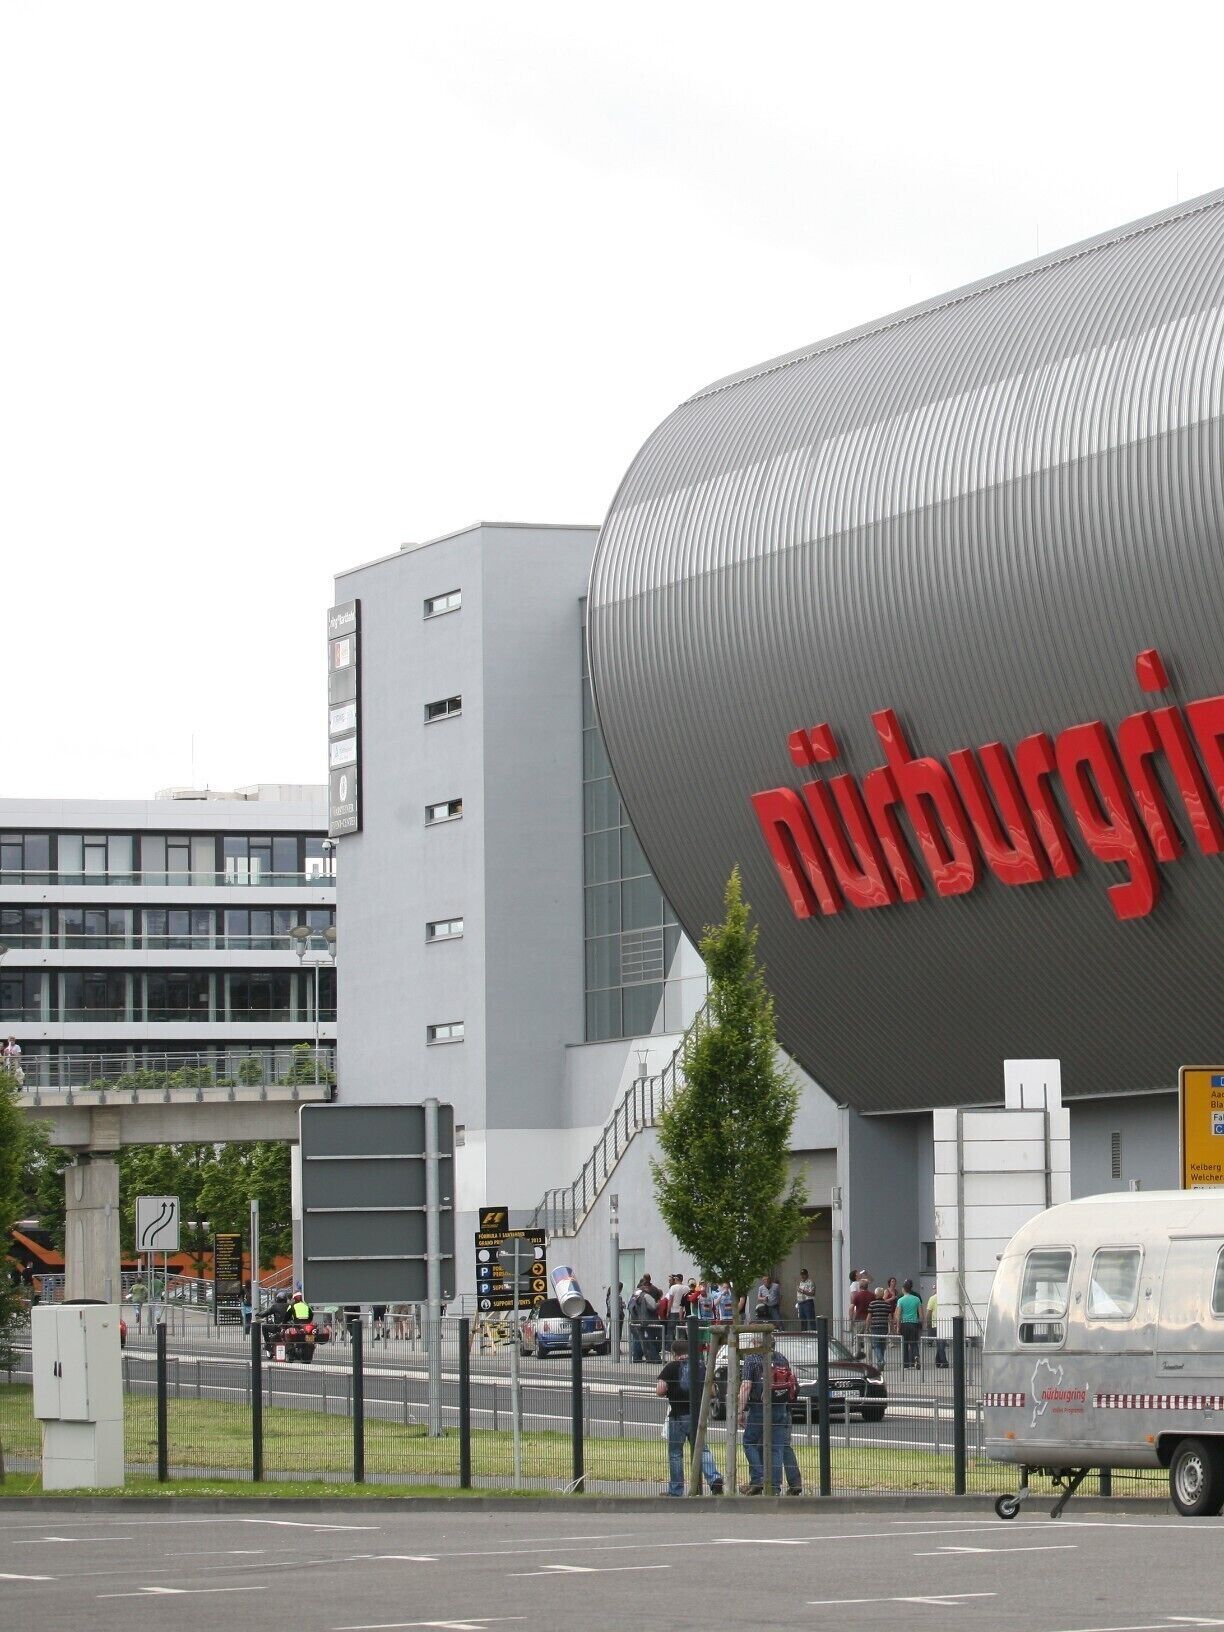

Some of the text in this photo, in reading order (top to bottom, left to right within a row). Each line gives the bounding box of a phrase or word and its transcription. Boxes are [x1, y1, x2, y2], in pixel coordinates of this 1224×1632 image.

[1190, 1163, 1221, 1171] Kelberg
[481, 1267, 488, 1277] P
[481, 1284, 489, 1293] P
[1041, 1387, 1086, 1402] nürburgring
